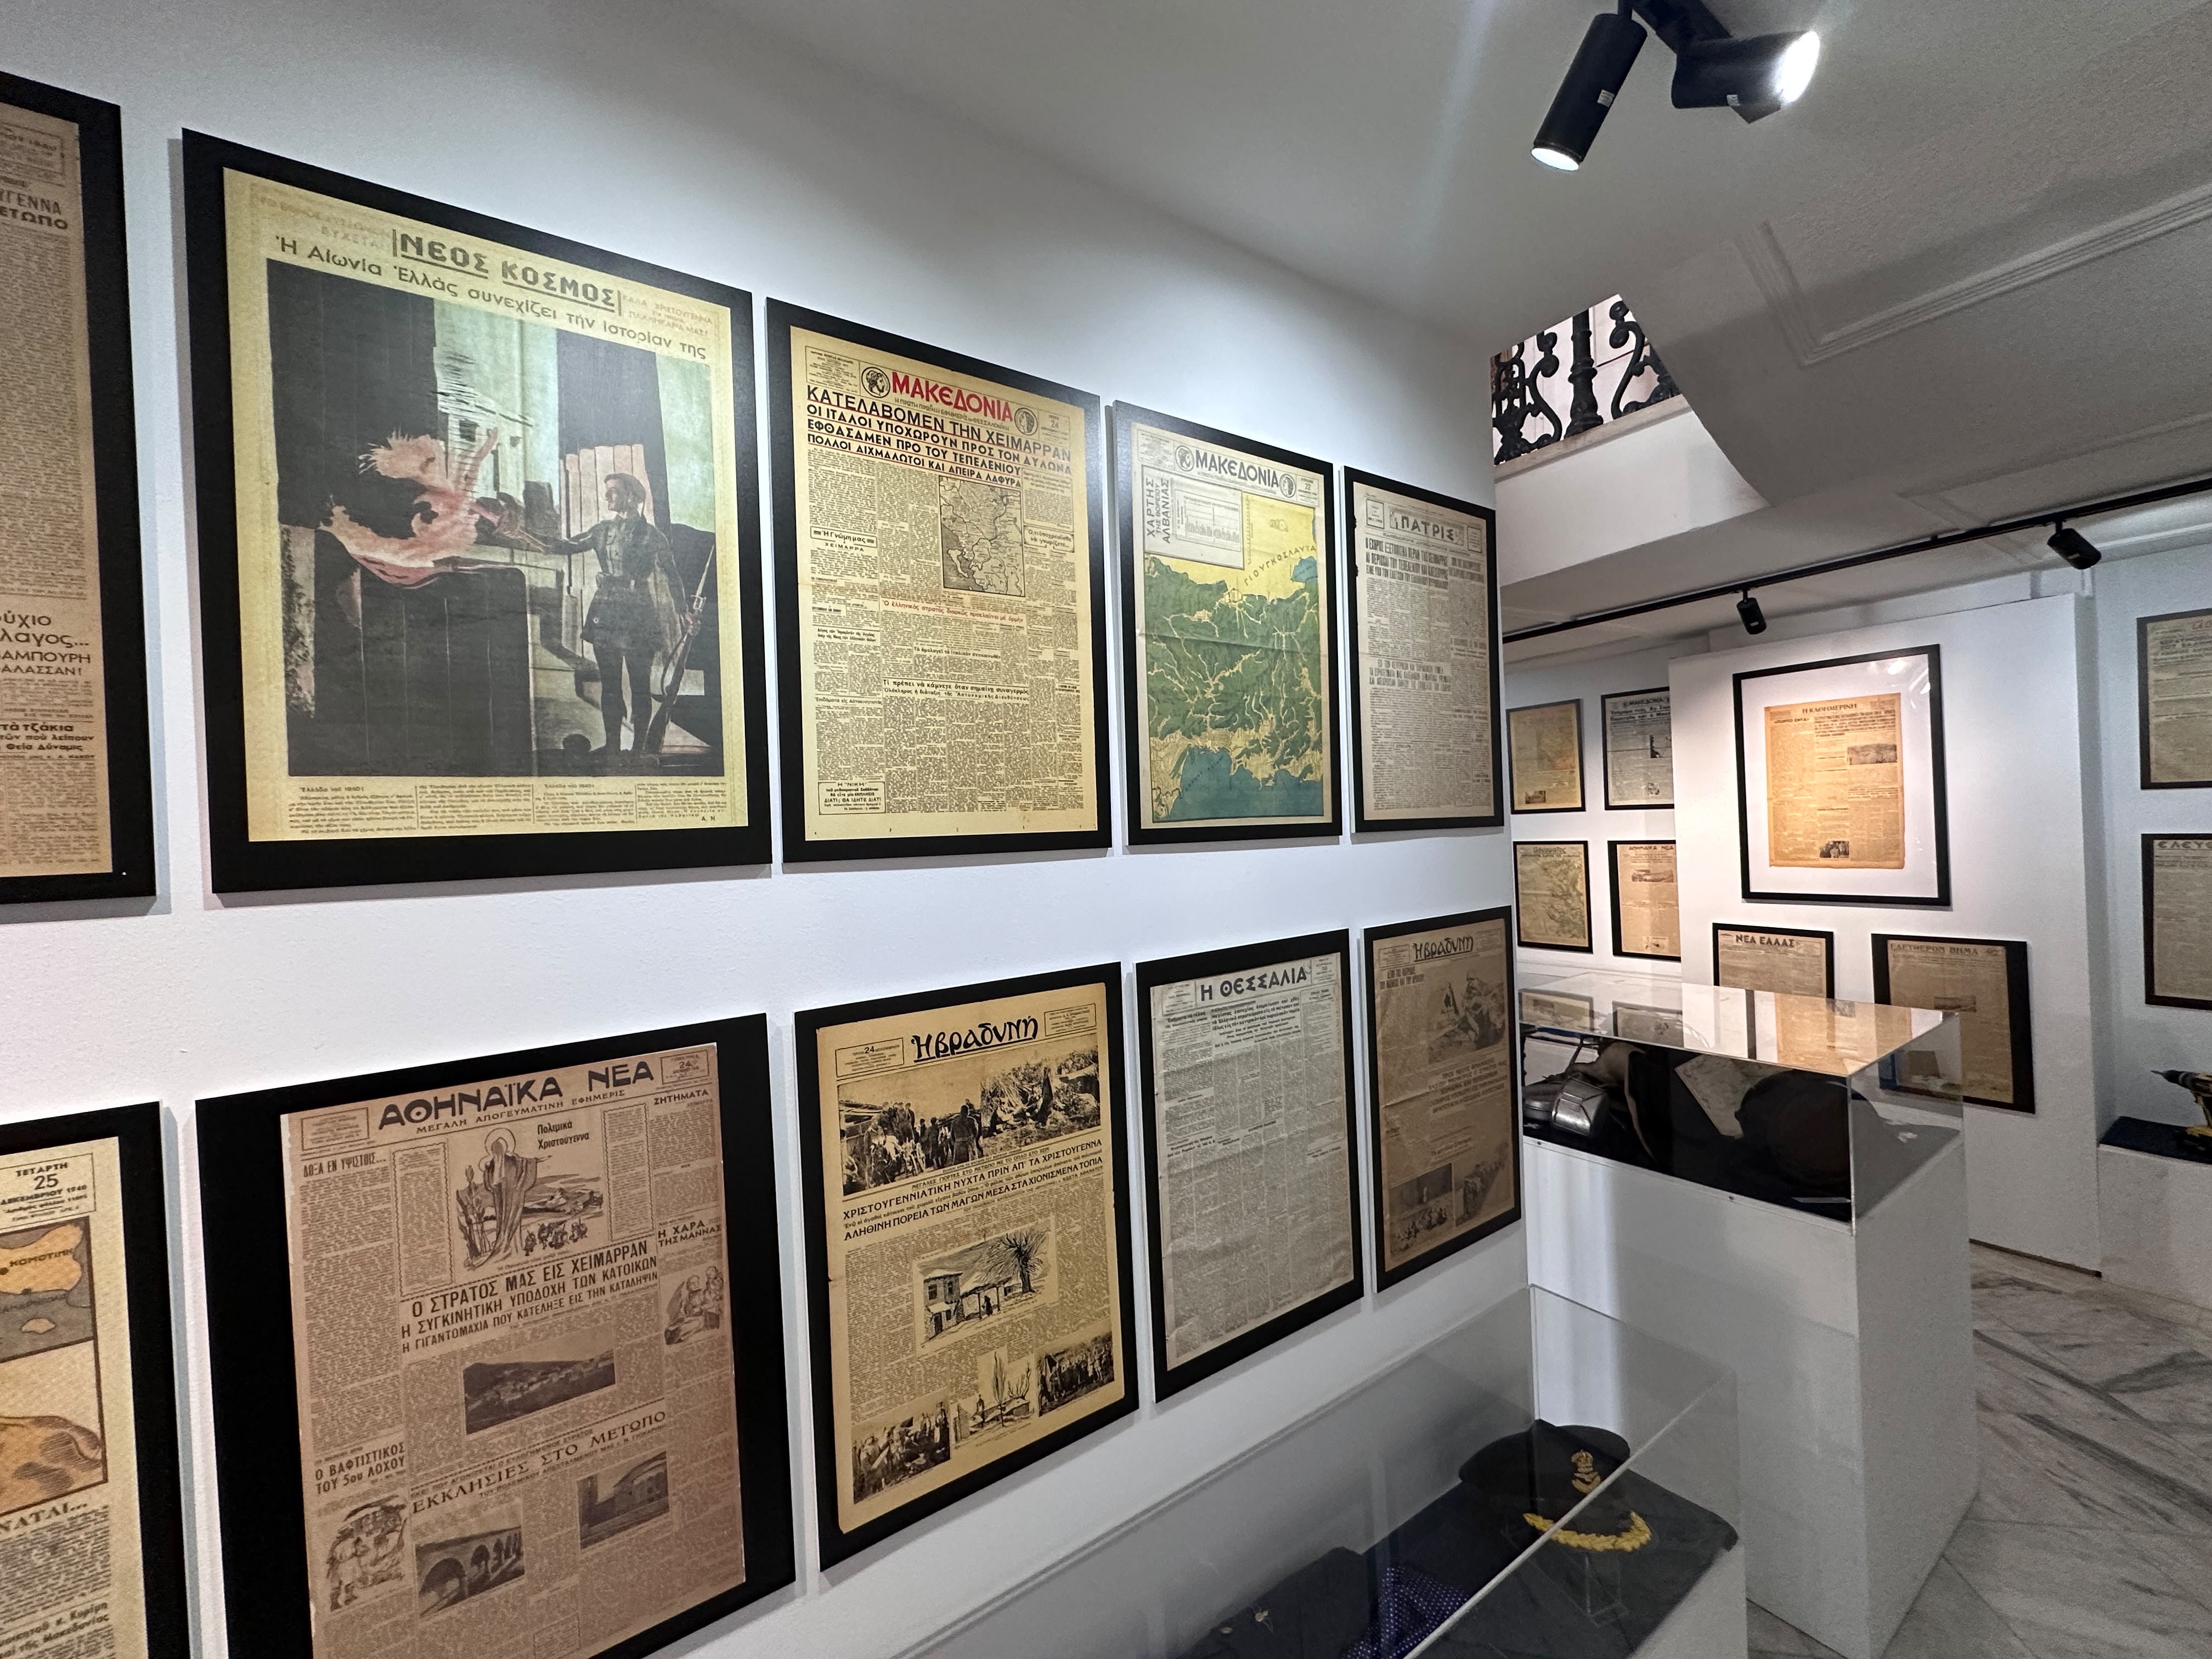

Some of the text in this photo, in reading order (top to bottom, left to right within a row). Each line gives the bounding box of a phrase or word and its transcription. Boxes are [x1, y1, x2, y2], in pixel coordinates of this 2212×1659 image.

[400, 234, 614, 307] ΝΕΟΣ ΚΟΣΜΟΣ
[468, 288, 556, 319] συνεχίζει
[891, 371, 1013, 422] ΜΑΚΕΔΟΝΙΑ
[807, 404, 1071, 474] ΟΙ ΙΤΑΛΟΙ ΥΠΟΧΩΡΟΥΝ ΠΡΟΣ ΤΟΝ ΑΥΛΩΝΑ
[808, 385, 1070, 461] ΚΑΤΕΛΑΒΟΜΕΝ ΤΗΝ ΧΕΙΜΑΡΡΑΝ
[1051, 420, 1059, 428] 24
[808, 419, 1020, 476] ΕΦΘΑΣΑΜΕΝ ΠΡΟ ΤΟΥ ΤΕΠΕΛΕΝΙΟΥ
[808, 433, 1021, 487] ΠΟΛΛΟΙ ΑΙΧΜΑΛΩΤΟΙ ΚΑΙ ΑΠΕΙΡΑ ΛΑΦΥΡΑ
[1195, 450, 1279, 488] ΜΑΚΕΔΟΝΙΑ
[1147, 477, 1155, 537] ΧΑΡΤΗΣ
[1161, 478, 1170, 544] ΑΛΒΑΝΙΑΣ
[825, 542, 864, 552] ΧΕΙΜΑΡΡΑ
[1401, 515, 1454, 541] ΠΑΤΡΙΣ
[0, 650, 91, 663] ΑΜΠΟΥΡΗ
[1809, 703, 1857, 713] ΚΑΘΗΜΕΡΙΝΗ
[1736, 934, 1795, 947] ΝΕΑ ΕΛΛΑΣ
[1201, 966, 1307, 1001] Η ΘΕΣΣΑΛΙΑ
[679, 1060, 692, 1069] 24
[379, 1061, 654, 1130] ΑΘΗΝΑΪΚΑ ΝΕΑ
[416, 1090, 625, 1134] ΜΕΓΑΛΗ ΑΠΟΓΕΥΜΑΤΙΝΗ ΕΦΗΜΕΡΙΣ
[654, 1089, 708, 1105] ΖΗΤΗΜΑΤΑ
[16, 1162, 68, 1177] ΤΕΤΑΡΤΗ
[34, 1173, 58, 1190] 25
[303, 1159, 337, 1177] ΔΟΞΑ ΕΝ
[843, 1183, 951, 1220] ΧΡΙΣΤΟΥΓΕΝΝΙΑΤΙΚΗ
[954, 1173, 985, 1189] ΝΥΧΤΑ
[988, 1166, 1009, 1178] ΠΡΙΝ
[1029, 1158, 1040, 1166] ΤΑ
[1042, 1139, 1102, 1163] ΧΡΙΣΤΟΥΓΕΝΝΑ
[912, 1179, 936, 1189] ΜΕΓΑΛΕΣ
[939, 1173, 960, 1182] ΓΙΟΡΤΕΣ
[962, 1169, 973, 1177] ΣΤΟ
[974, 1162, 995, 1172] ΜΕΤΩΠΟ
[844, 1220, 891, 1240] ΑΛΗΘΙΝΗ
[893, 1210, 929, 1227] ΠΟΡΕΙΑ
[931, 1204, 950, 1215] ΤΩΝ
[951, 1193, 984, 1209] ΜΑΓΩΝ
[985, 1186, 1010, 1199] ΜΕΣΑ
[1012, 1180, 1028, 1190] ΣΤΑ
[1029, 1164, 1079, 1185] ΧΙΟΝΙΣΜΕΝΑ
[658, 1220, 705, 1239] Η ΧΑΡΑ
[658, 1224, 721, 1247] ΤΗΣ ΜΑΝΝΑΣ
[9, 1248, 73, 1267] ΚΟΜΟΤΙΝΗ
[402, 1256, 657, 1339] Η ΣΥΓΚΙΝΗΤΙΚΗ ΥΠΟΔΟΧΗ ΤΩΝ ΚΑΤΟΙΚΩΝ
[413, 1240, 647, 1317] Ο ΣΤΡΑΤΟΣ ΜΑΣ ΕΙΣ ΧΕΙΜΑΡΡΑΝ
[402, 1272, 657, 1353] Η ΓΙΓΑΝΤΟΜΑΧΙΑ ΠΟΥ ΚΑΤΕΛΗΞΕ ΕΙΣ ΤΗΝ ΚΑΤΑΛΗΨΙΝ
[315, 1442, 404, 1480] Ο ΒΑΦΤΙΣΤΙΚΟΣ
[317, 1455, 404, 1494] ΤΟΥ 5ου ΛΟΧΟΥ
[413, 1411, 665, 1514] ΕΚΚΛΗΣΙΕΣ ΣΤΟ ΜΕΤΩΠΟ
